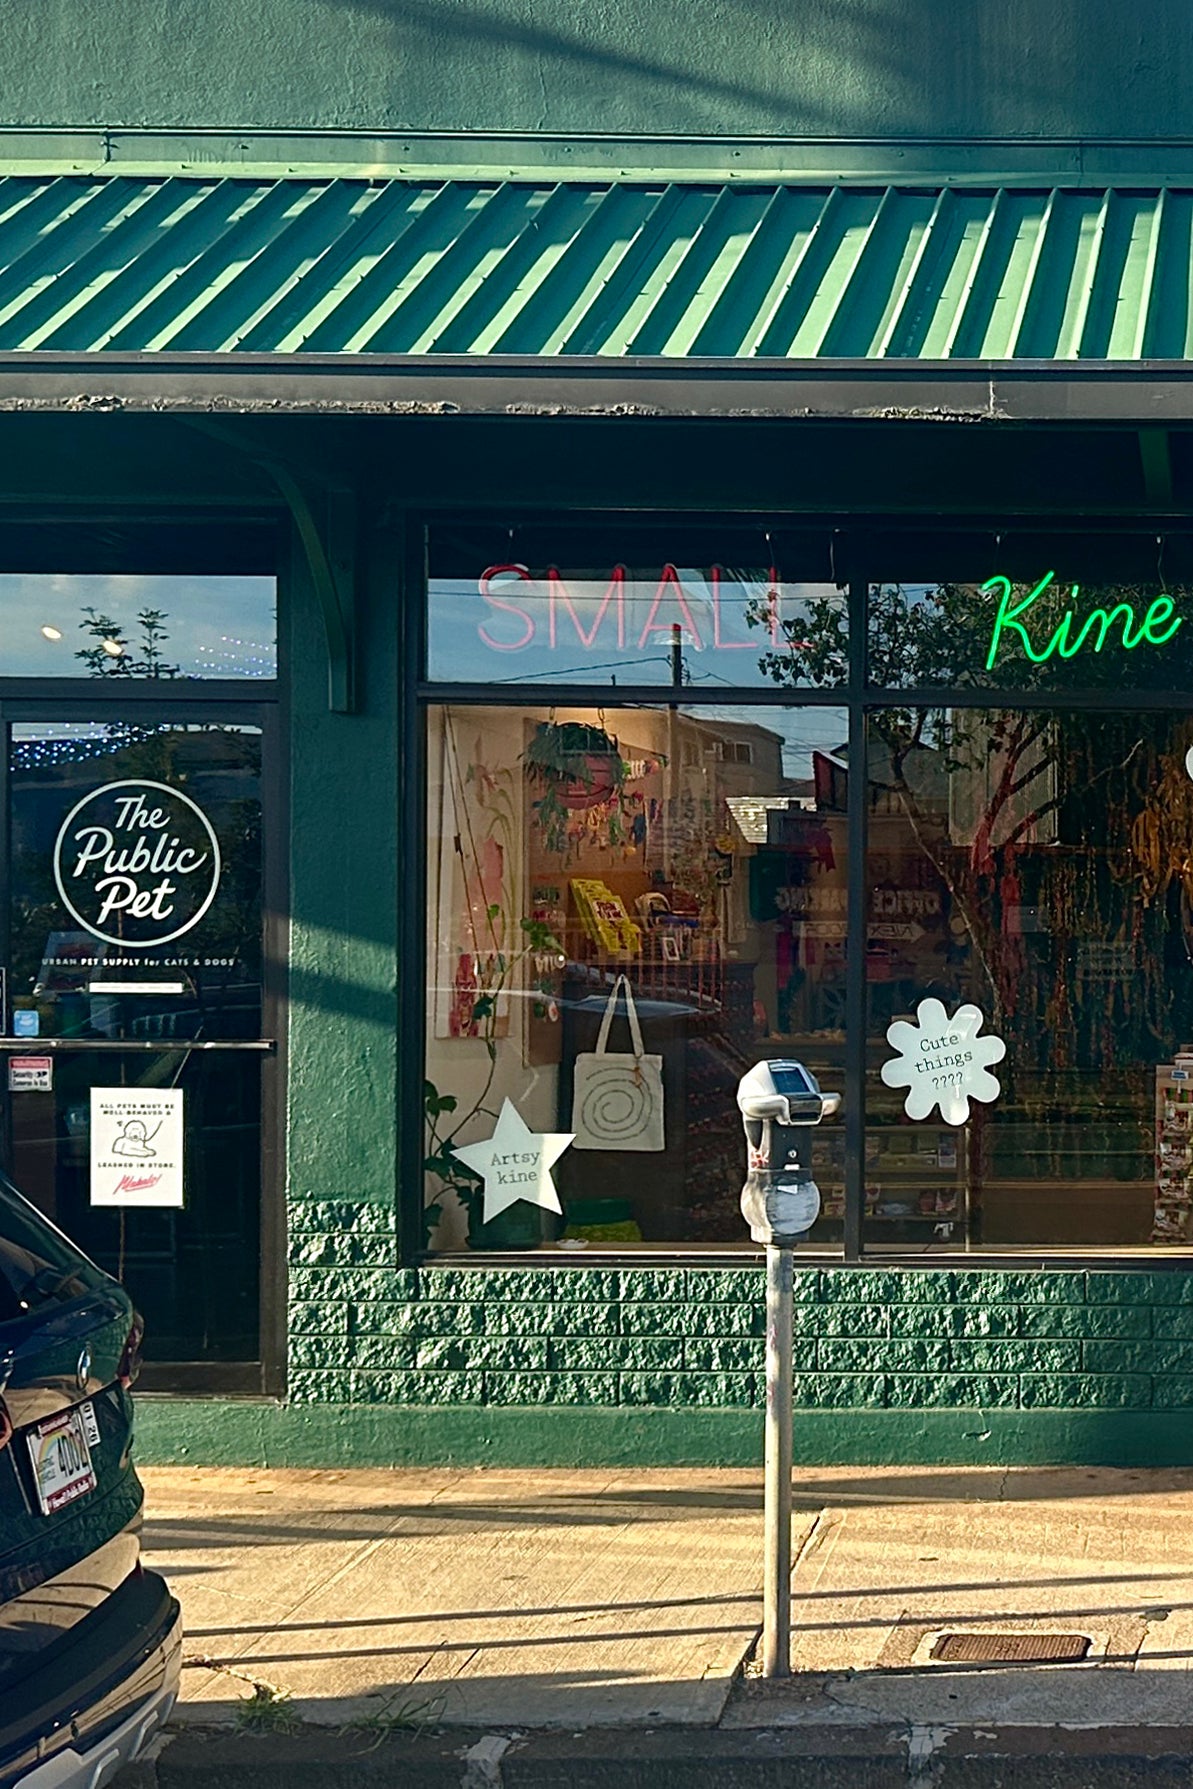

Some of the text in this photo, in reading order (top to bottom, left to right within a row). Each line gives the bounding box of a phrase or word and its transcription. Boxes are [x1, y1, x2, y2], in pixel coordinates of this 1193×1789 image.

[477, 562, 816, 652] SMALL
[980, 569, 1183, 671] Kine
[114, 793, 170, 832] The
[72, 826, 207, 878] Public
[95, 875, 176, 925] Pet
[41, 958, 234, 966] URBAN PET SUPPLY for CATS & DOGS
[920, 1033, 960, 1053] Cute
[914, 1050, 973, 1074] things
[932, 1071, 964, 1090] ????
[490, 1151, 541, 1167] Artsy
[496, 1169, 538, 1185] kine
